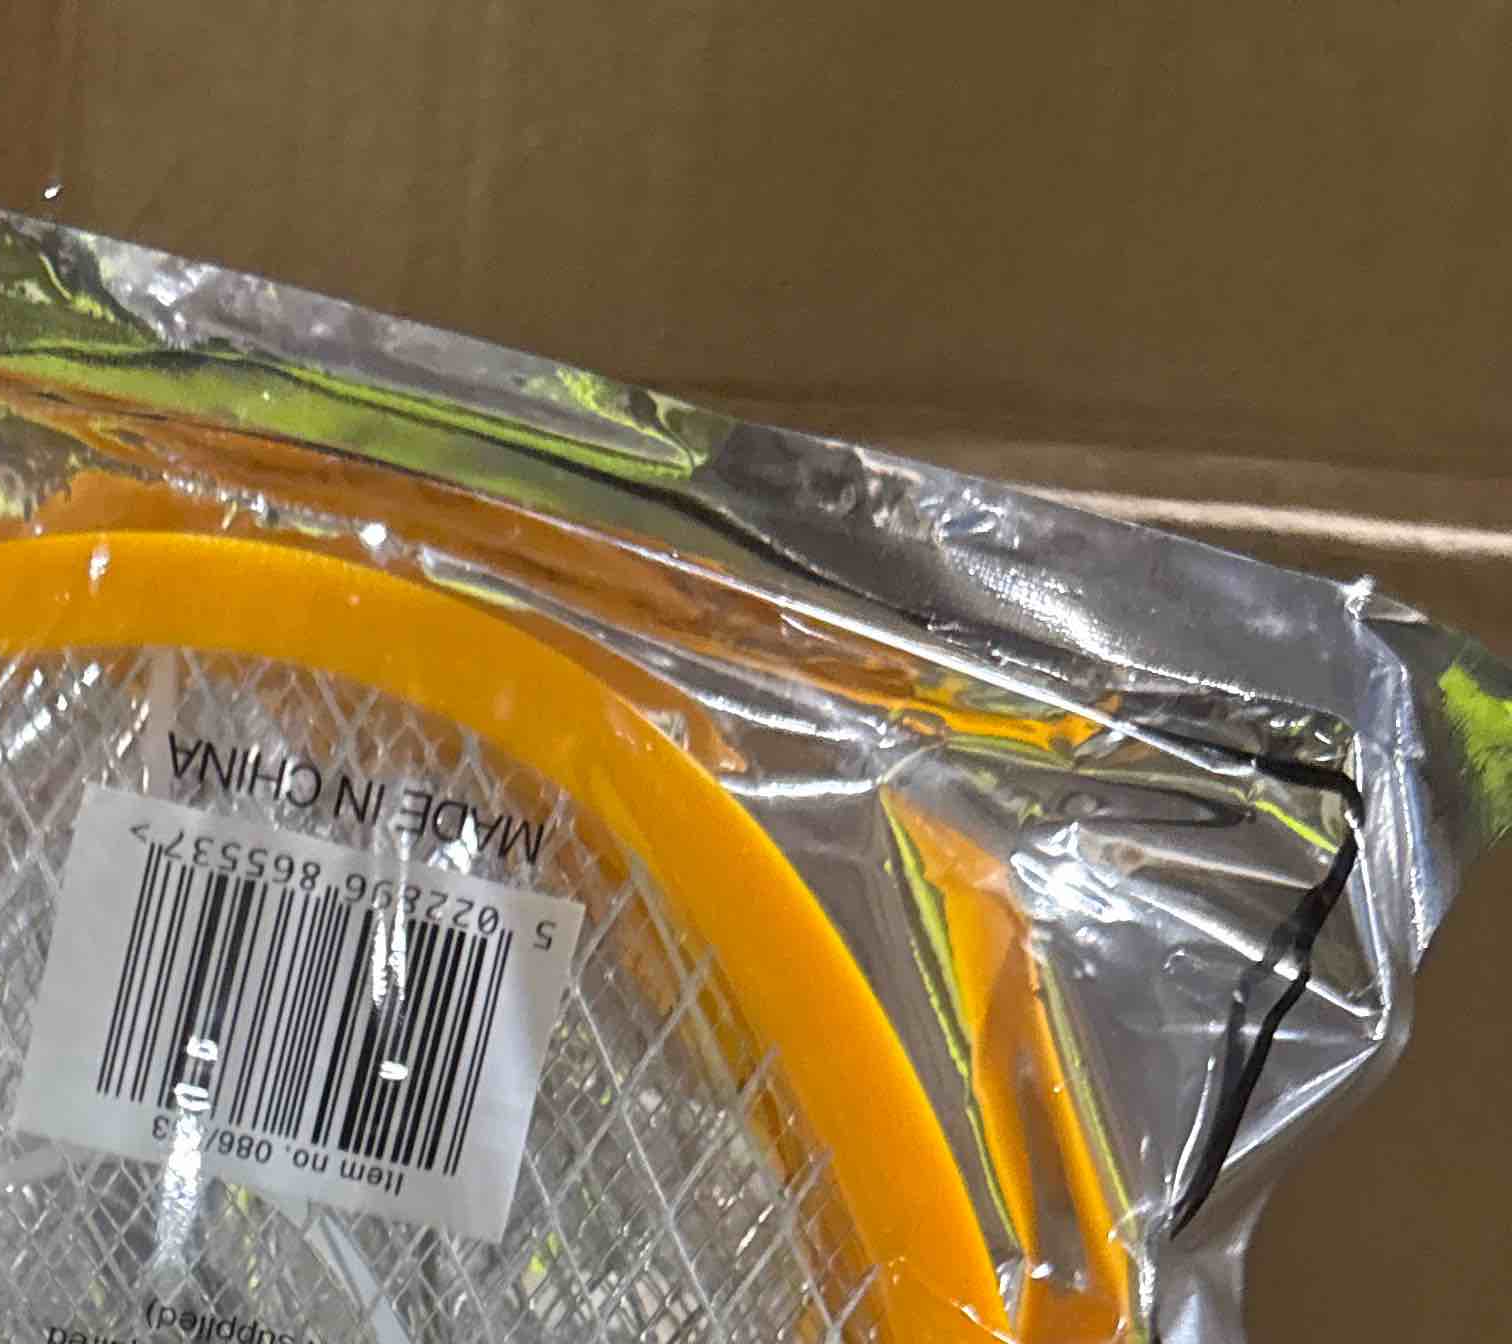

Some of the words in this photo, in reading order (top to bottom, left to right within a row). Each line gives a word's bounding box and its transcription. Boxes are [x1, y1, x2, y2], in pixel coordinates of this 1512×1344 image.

[159, 729, 326, 812] CHINA
[331, 774, 383, 824] IN
[393, 788, 546, 866] MADE
[160, 825, 322, 893] 865537
[340, 870, 501, 936] 022896
[531, 918, 557, 949] 5
[148, 1111, 274, 1166] 086/3
[281, 1144, 329, 1176] no.
[336, 1157, 405, 1195] Item
